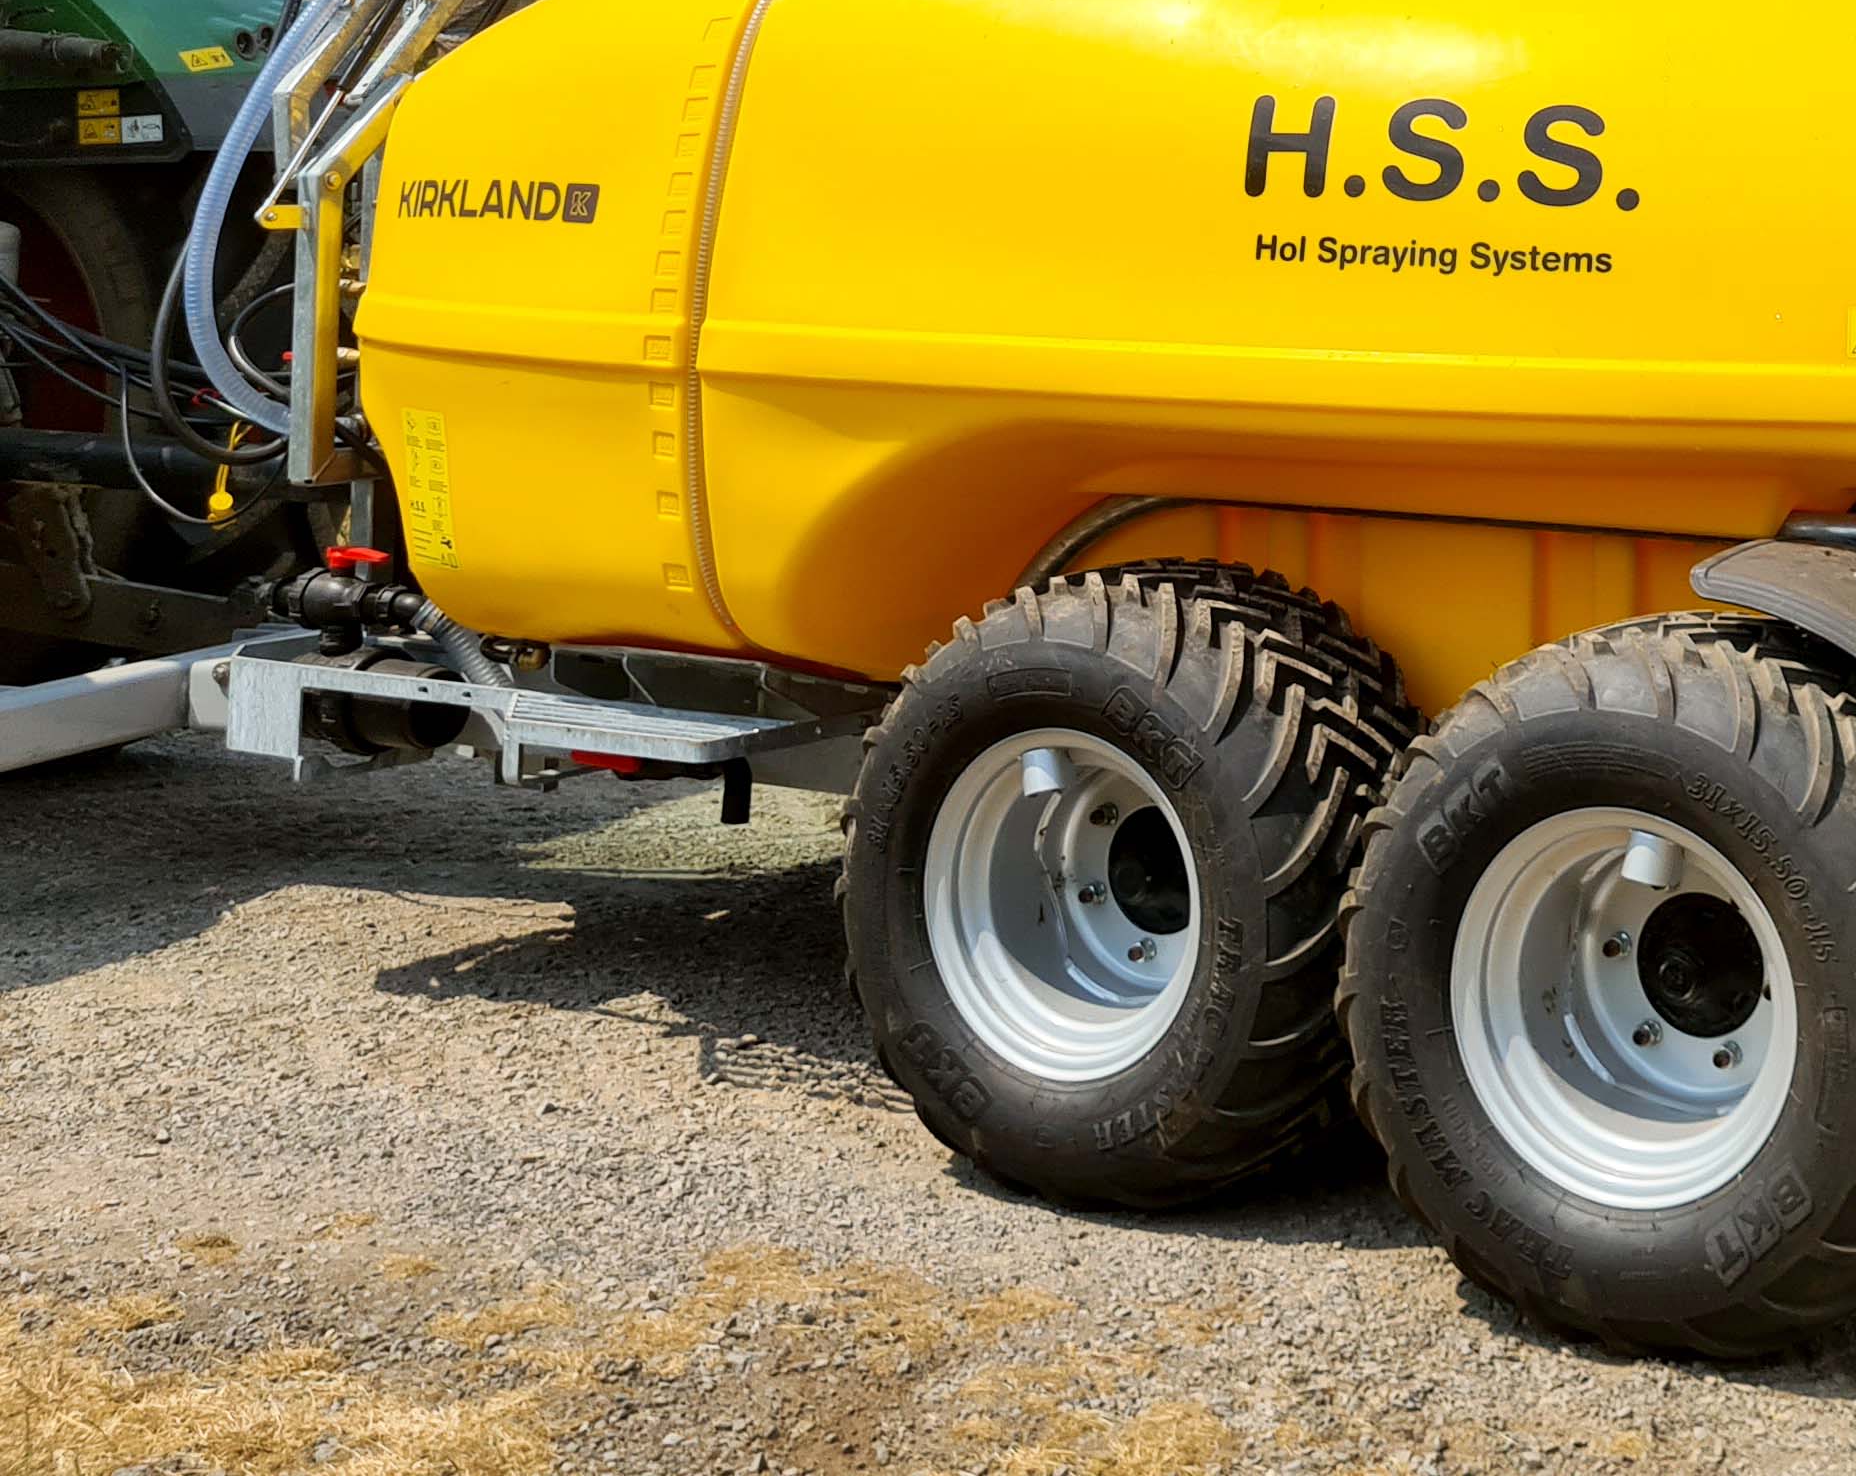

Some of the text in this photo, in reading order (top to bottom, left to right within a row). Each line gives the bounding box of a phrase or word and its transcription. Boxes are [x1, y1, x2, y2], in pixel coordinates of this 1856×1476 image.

[398, 179, 561, 221] KIRKLAND
[1244, 95, 1640, 211] H.S.S.
[1255, 233, 1613, 277] Hol Spraying Systems
[1417, 754, 1514, 875] BKT
[1380, 994, 1474, 1194] MASTER
[1705, 1156, 1815, 1288] BKT
